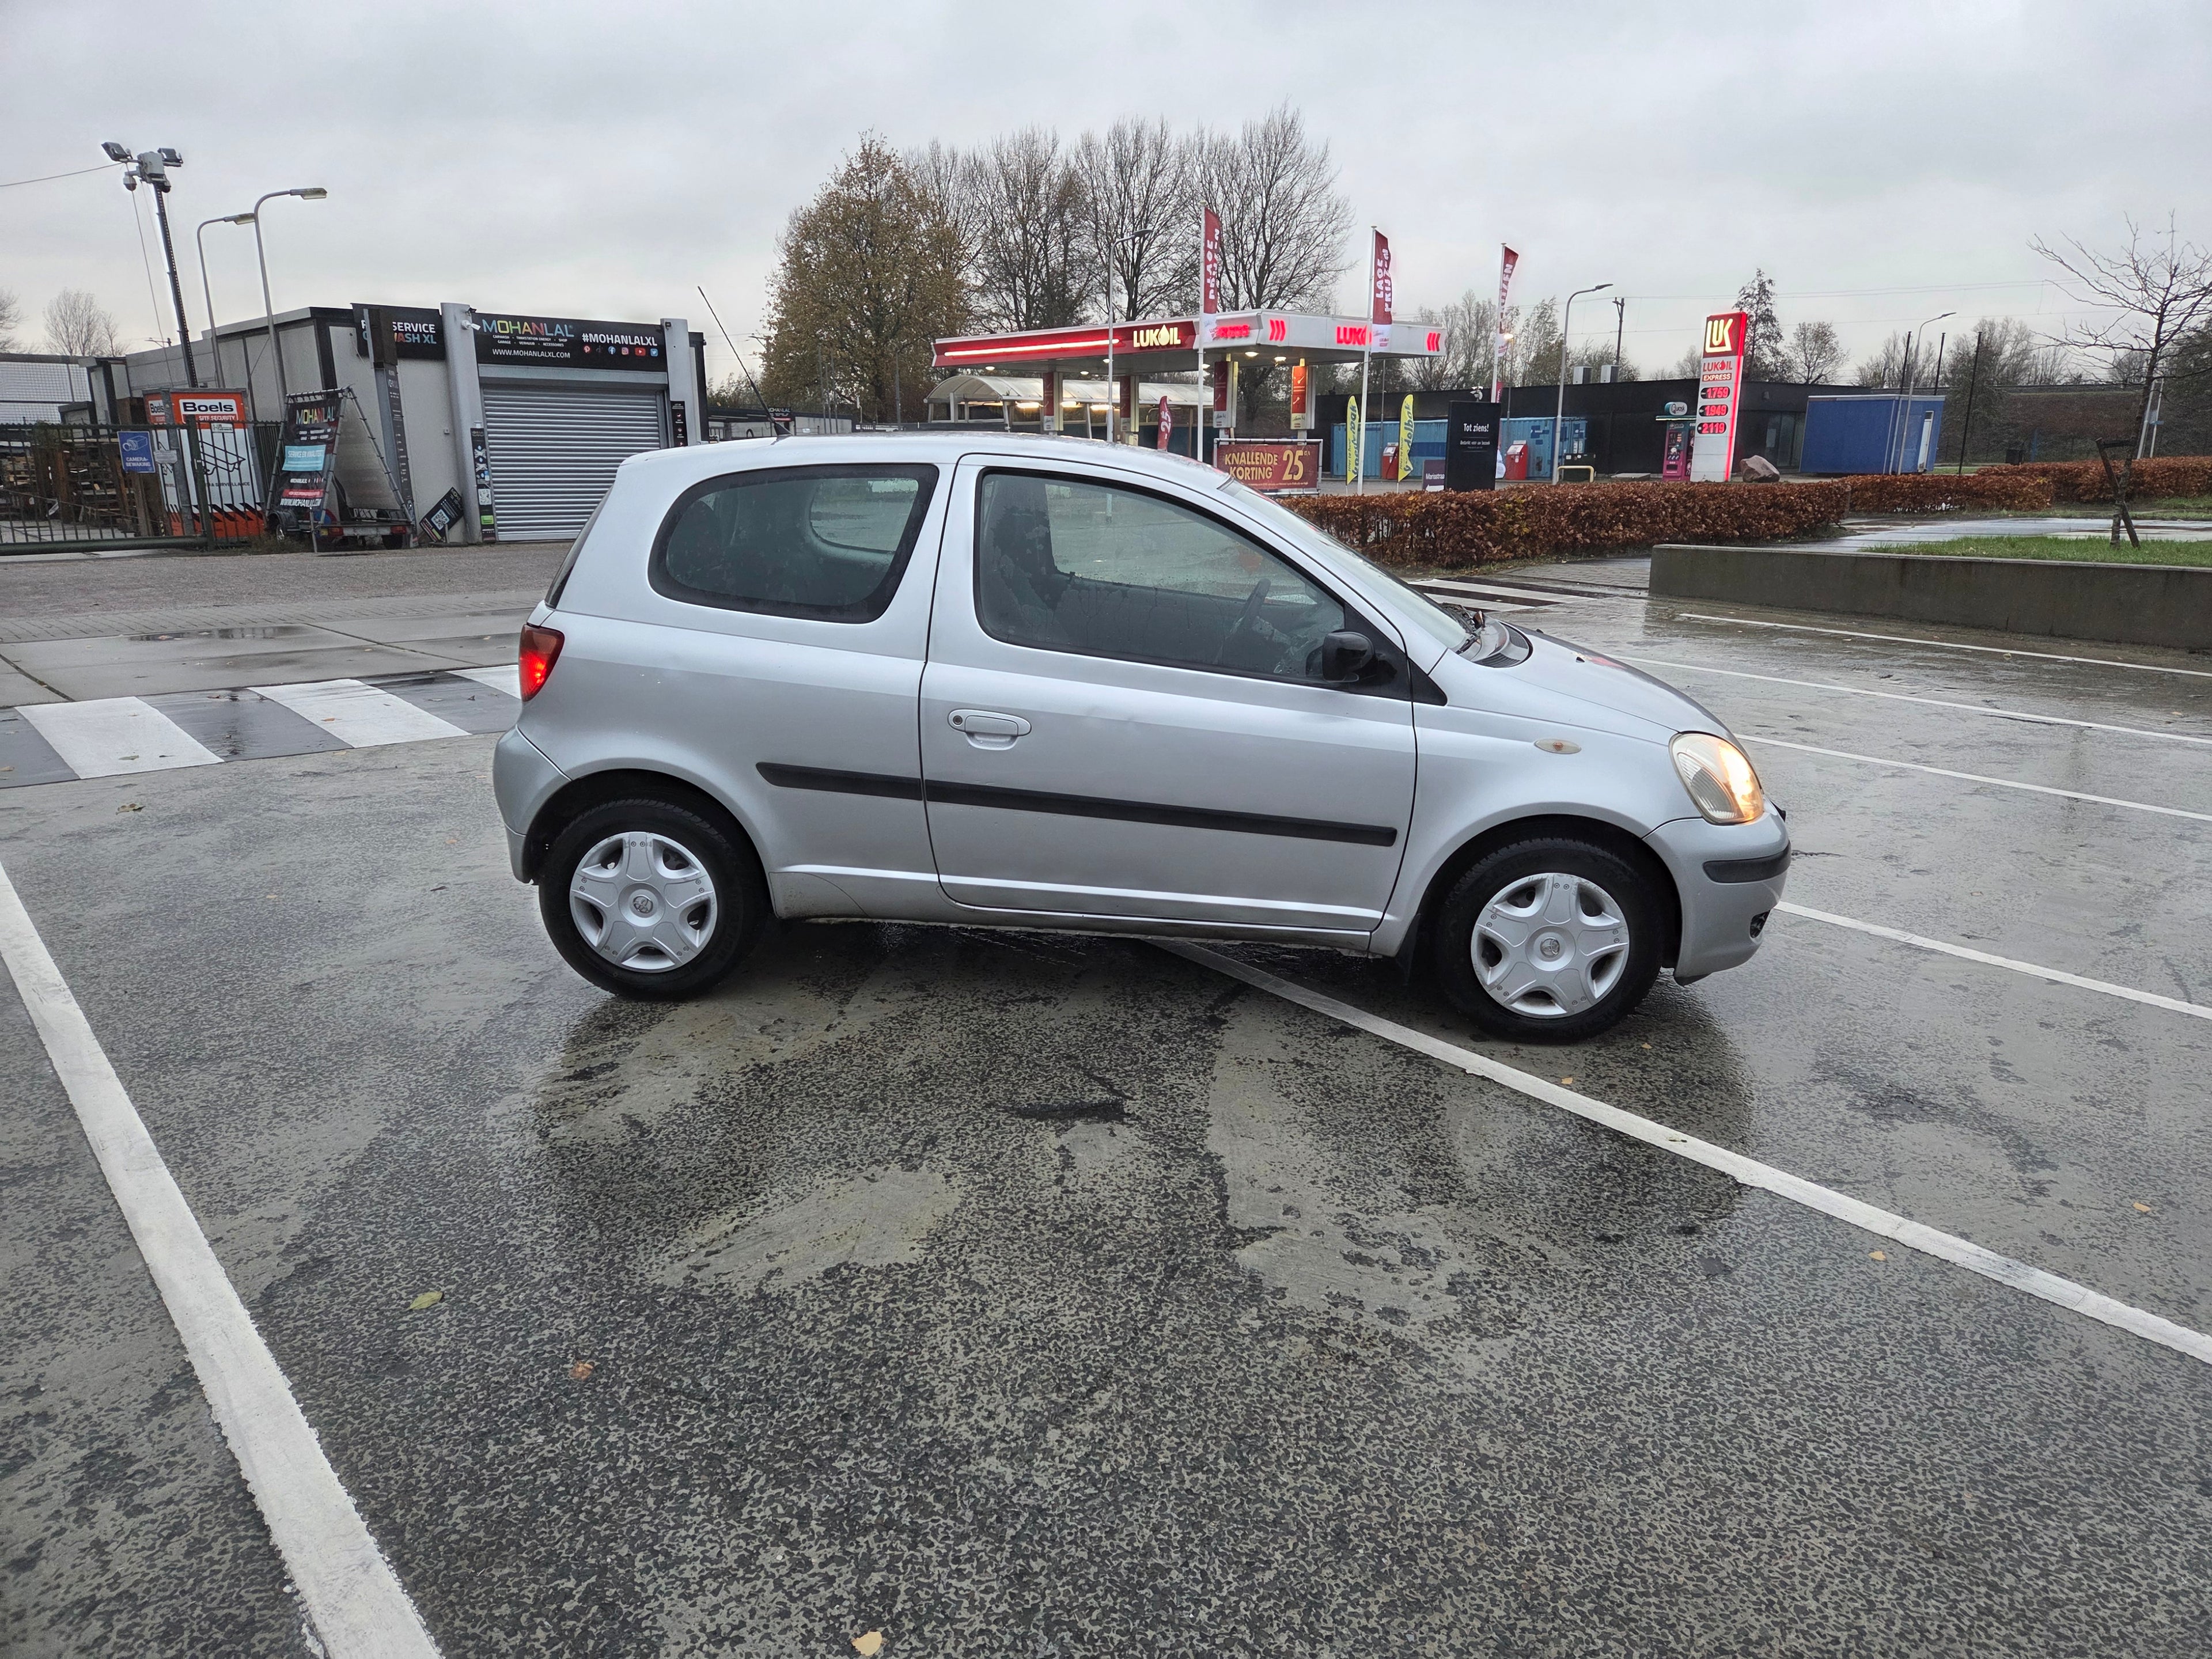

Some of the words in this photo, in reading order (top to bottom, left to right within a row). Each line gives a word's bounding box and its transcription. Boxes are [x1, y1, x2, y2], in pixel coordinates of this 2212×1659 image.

[392, 321, 436, 333] SERVICE
[482, 319, 575, 337] MOHANLAL
[422, 334, 437, 344] XL
[582, 333, 658, 346] #MOHANLALXL
[1133, 324, 1181, 347] LUKOIL
[1705, 318, 1733, 353] LUK
[492, 349, 570, 358] WWW.MOHANLALXL.COM
[1703, 359, 1733, 372] LUKOIL
[1706, 387, 1728, 399] 1.759
[182, 402, 234, 412] Boels
[1464, 423, 1472, 431] Tot
[1473, 423, 1489, 432] ziens!
[1225, 452, 1278, 465] KNALLENDE
[1282, 450, 1304, 480] 25
[1230, 467, 1272, 480] KORTING
